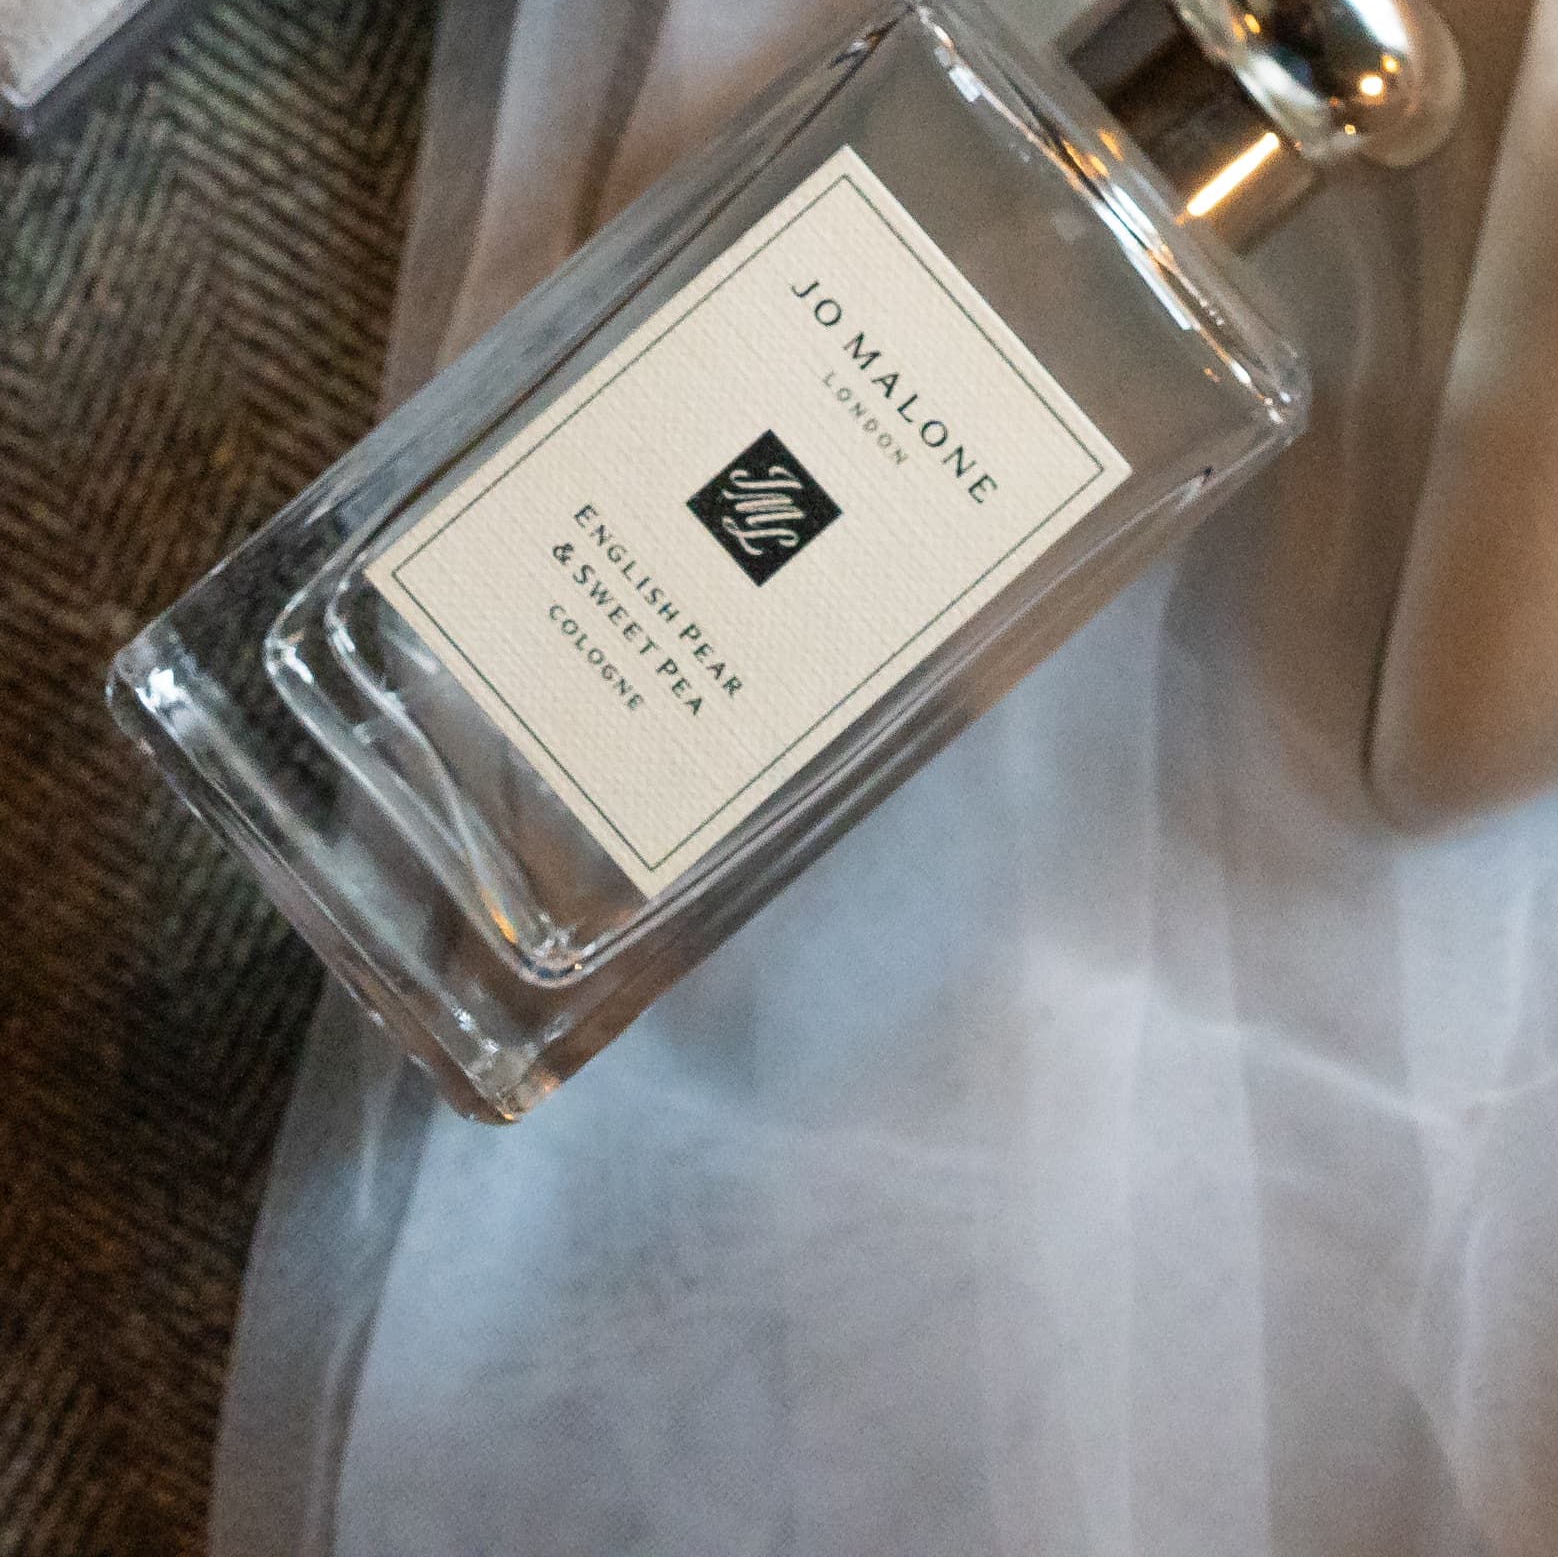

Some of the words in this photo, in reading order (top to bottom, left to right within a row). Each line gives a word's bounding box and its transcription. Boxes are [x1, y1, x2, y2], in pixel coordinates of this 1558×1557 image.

[790, 280, 842, 327] JO
[843, 332, 998, 504] MALONE
[822, 372, 909, 465] LONDON
[548, 603, 645, 711] COLOGNE
[552, 542, 575, 567] &
[573, 564, 659, 657] SWEET
[656, 658, 703, 716] PEA
[573, 502, 679, 622] ENGLISH
[679, 623, 743, 698] PEAR
